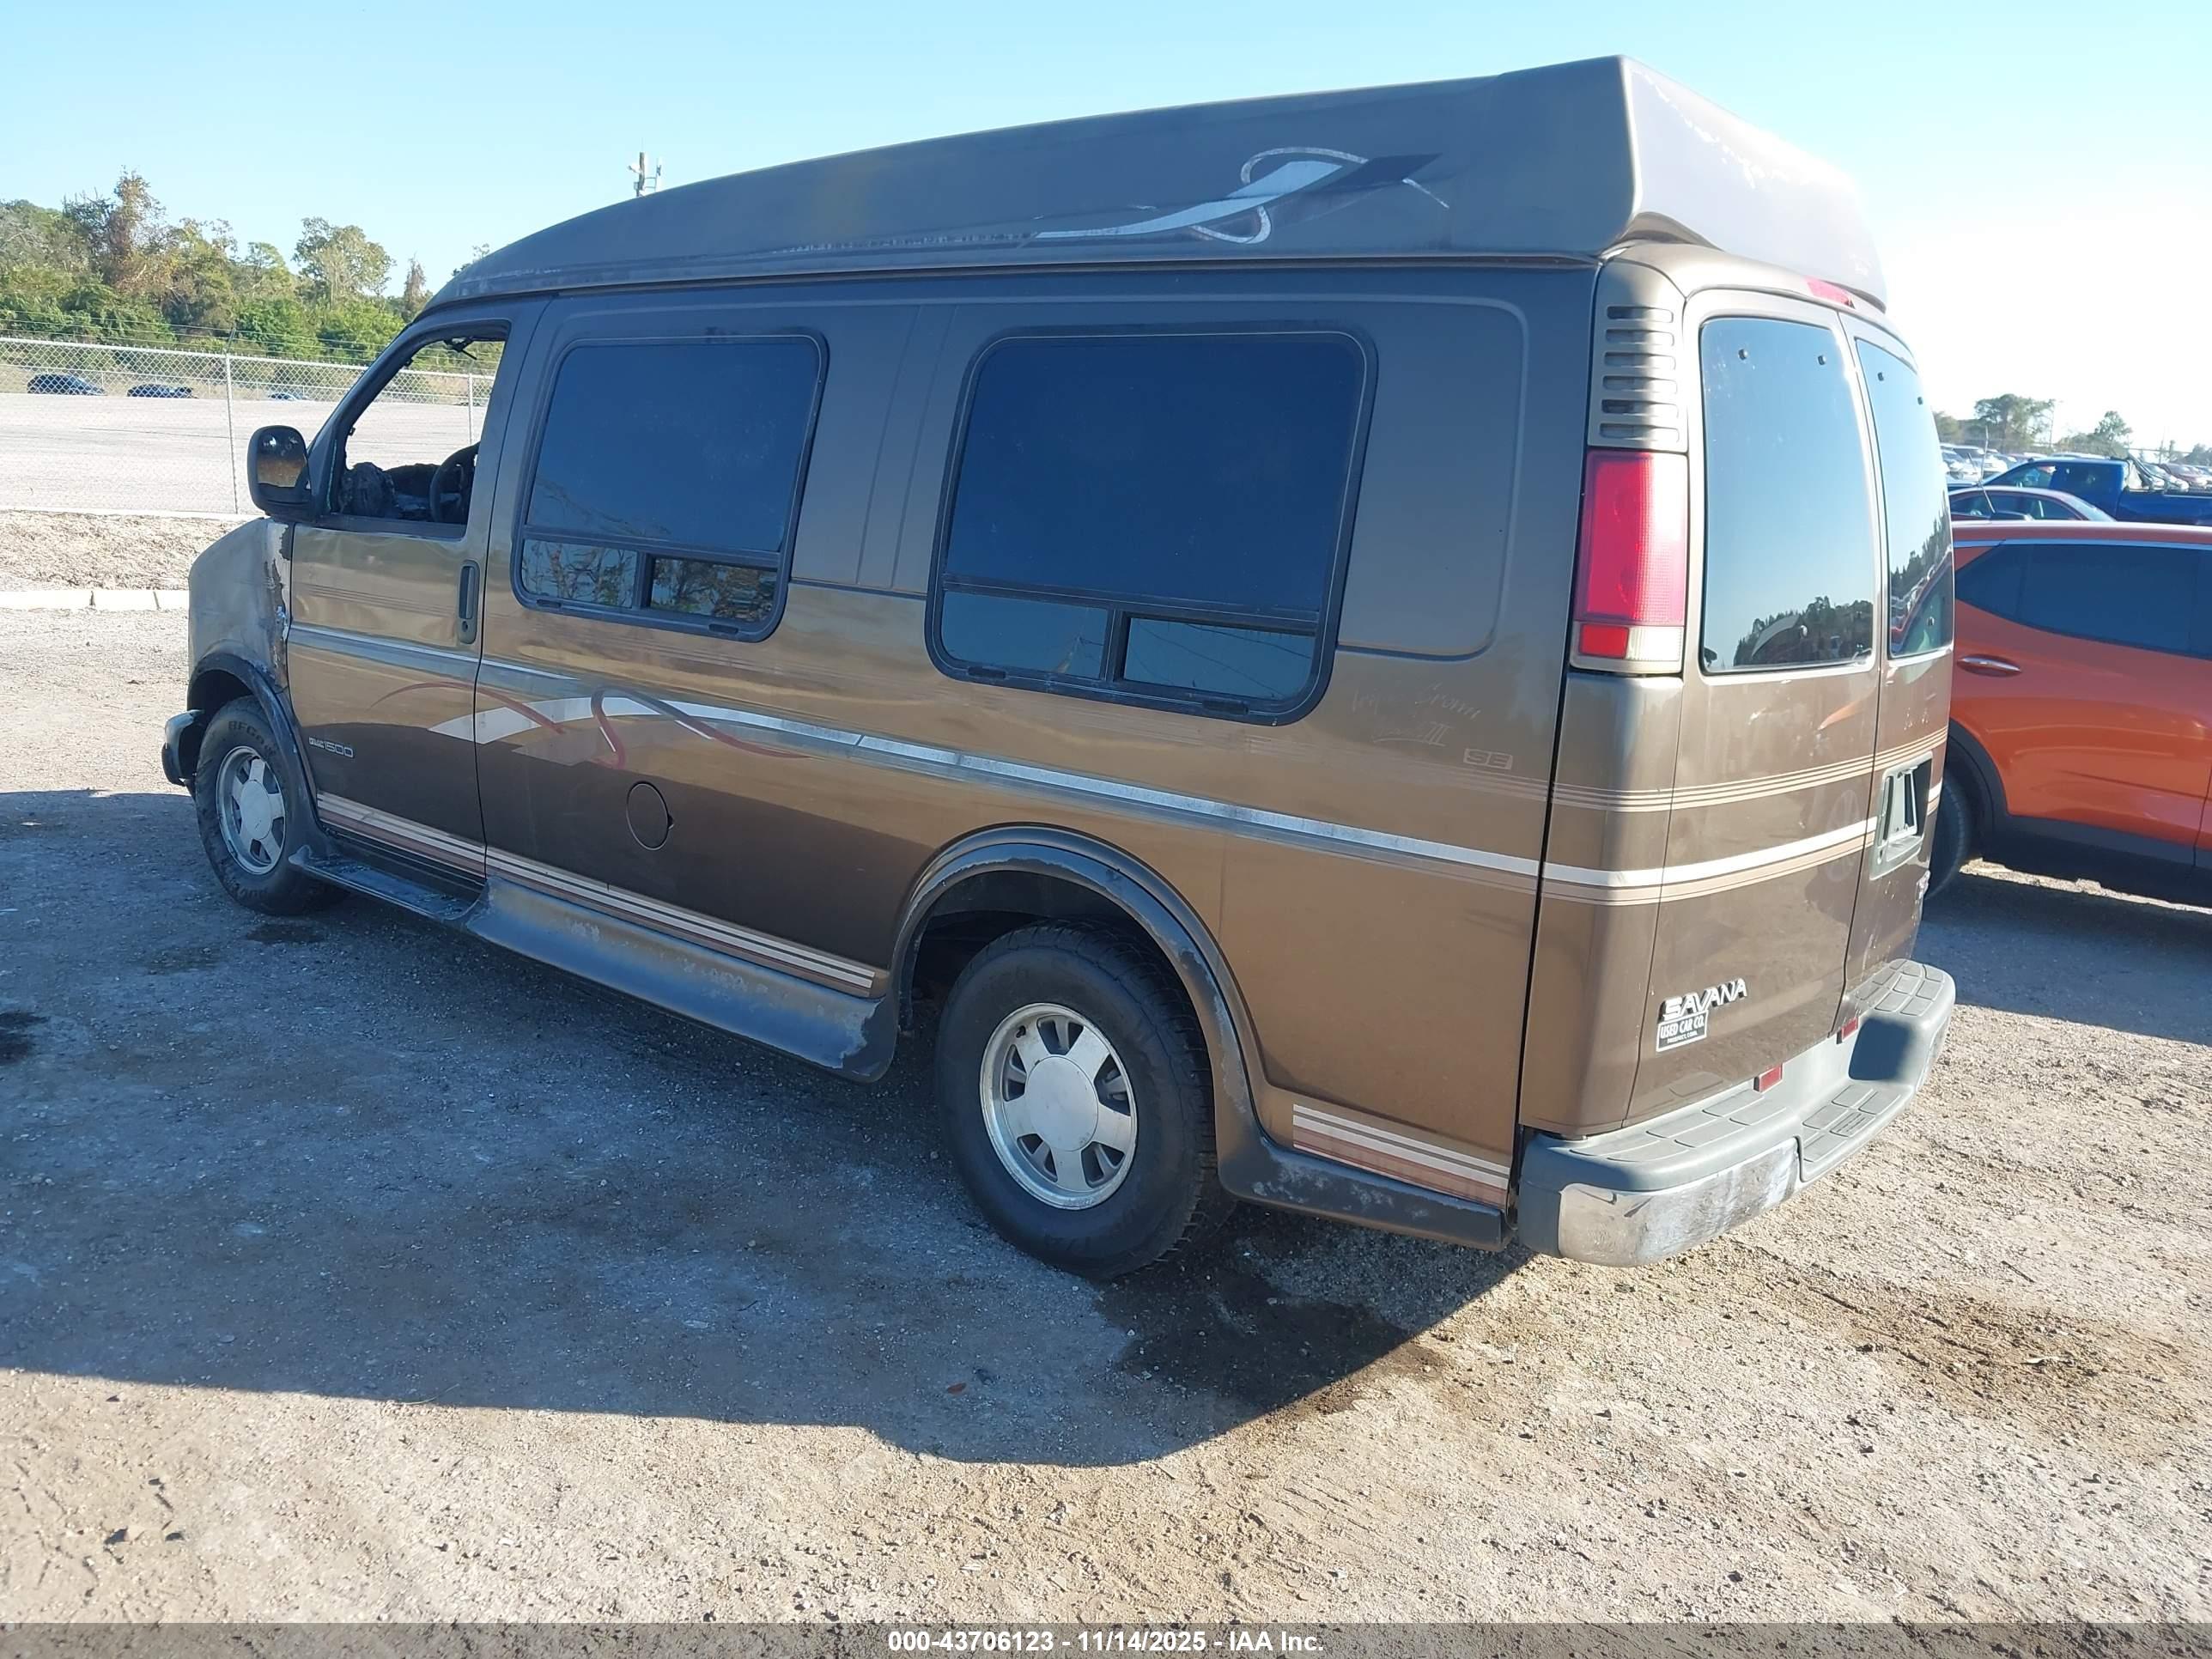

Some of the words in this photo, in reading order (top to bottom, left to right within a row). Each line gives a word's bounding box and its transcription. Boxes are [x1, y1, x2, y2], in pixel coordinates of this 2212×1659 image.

[1662, 978, 1747, 1021] SAVANA
[1660, 1023, 1679, 1039] USED
[1680, 1018, 1693, 1034] CAR
